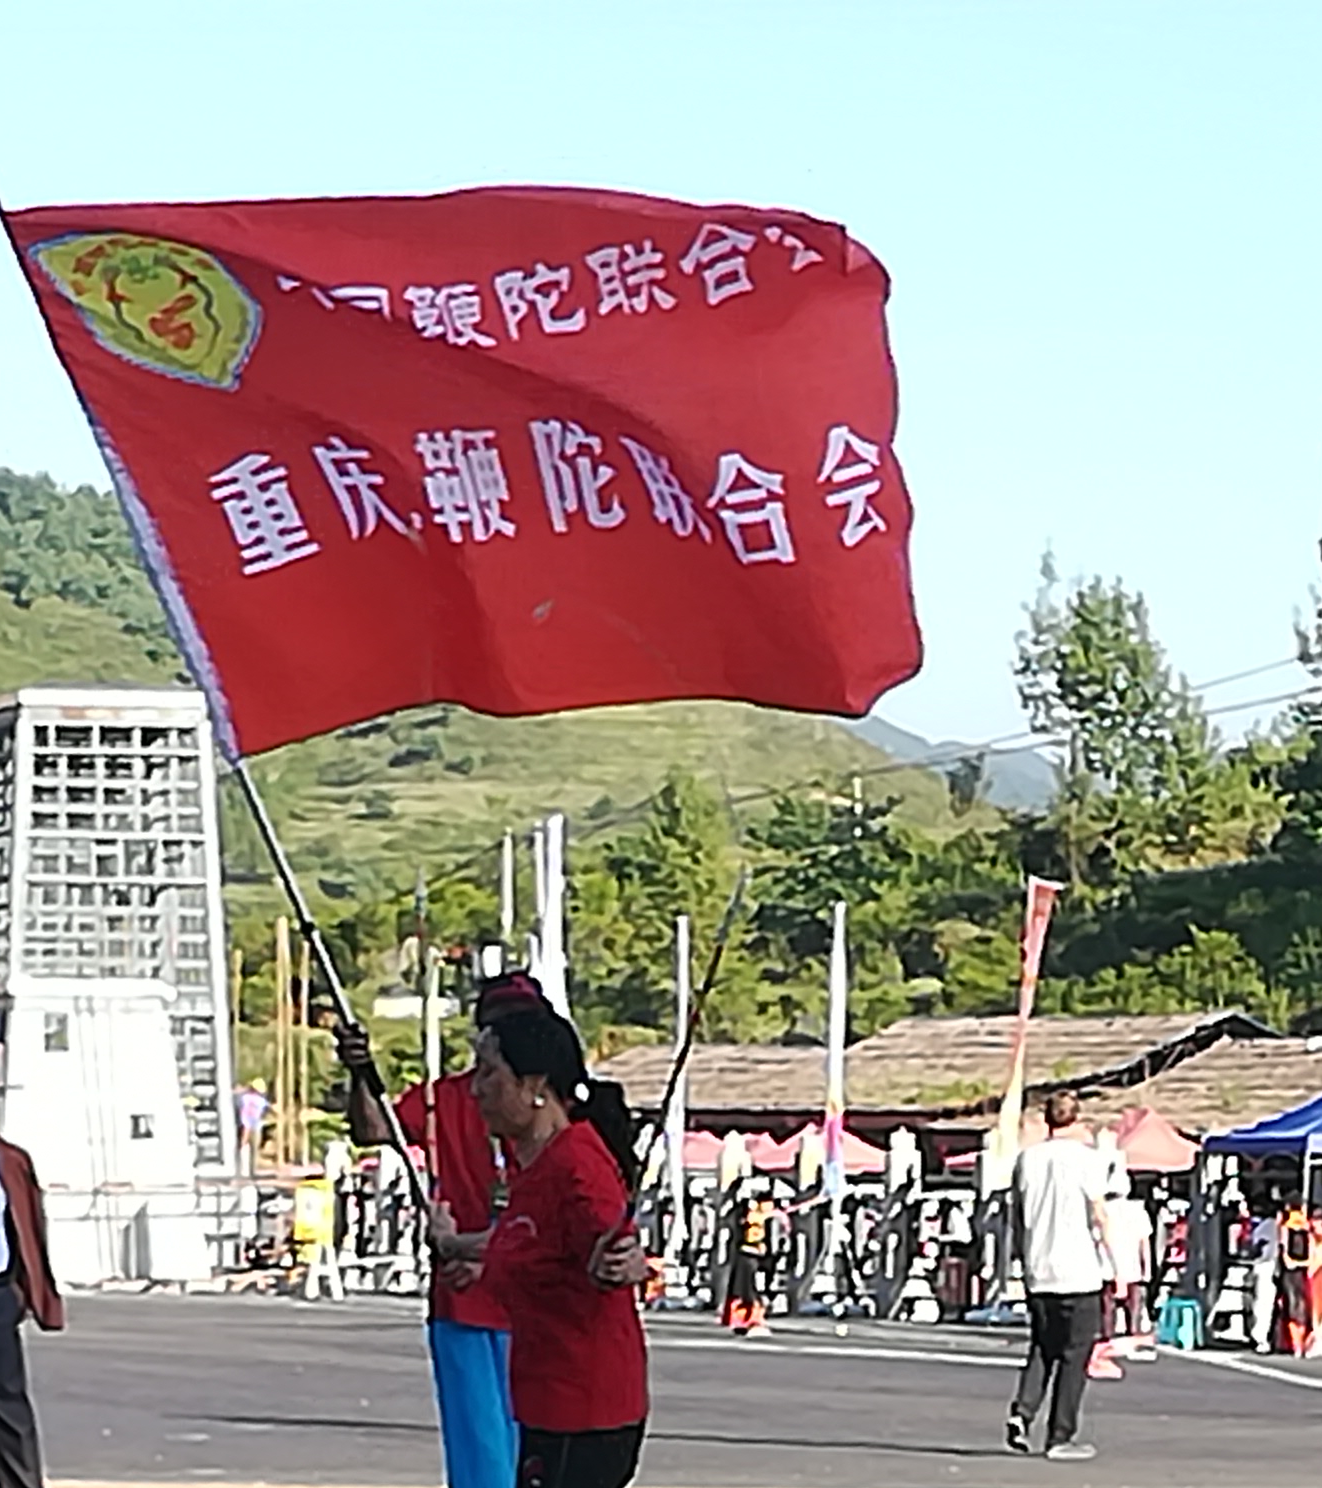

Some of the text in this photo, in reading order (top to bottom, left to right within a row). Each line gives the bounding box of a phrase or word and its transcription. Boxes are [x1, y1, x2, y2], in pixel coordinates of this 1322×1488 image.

[276, 221, 825, 348] 鞭陀联合
[208, 419, 887, 576] 重庆鞭陀联合会
